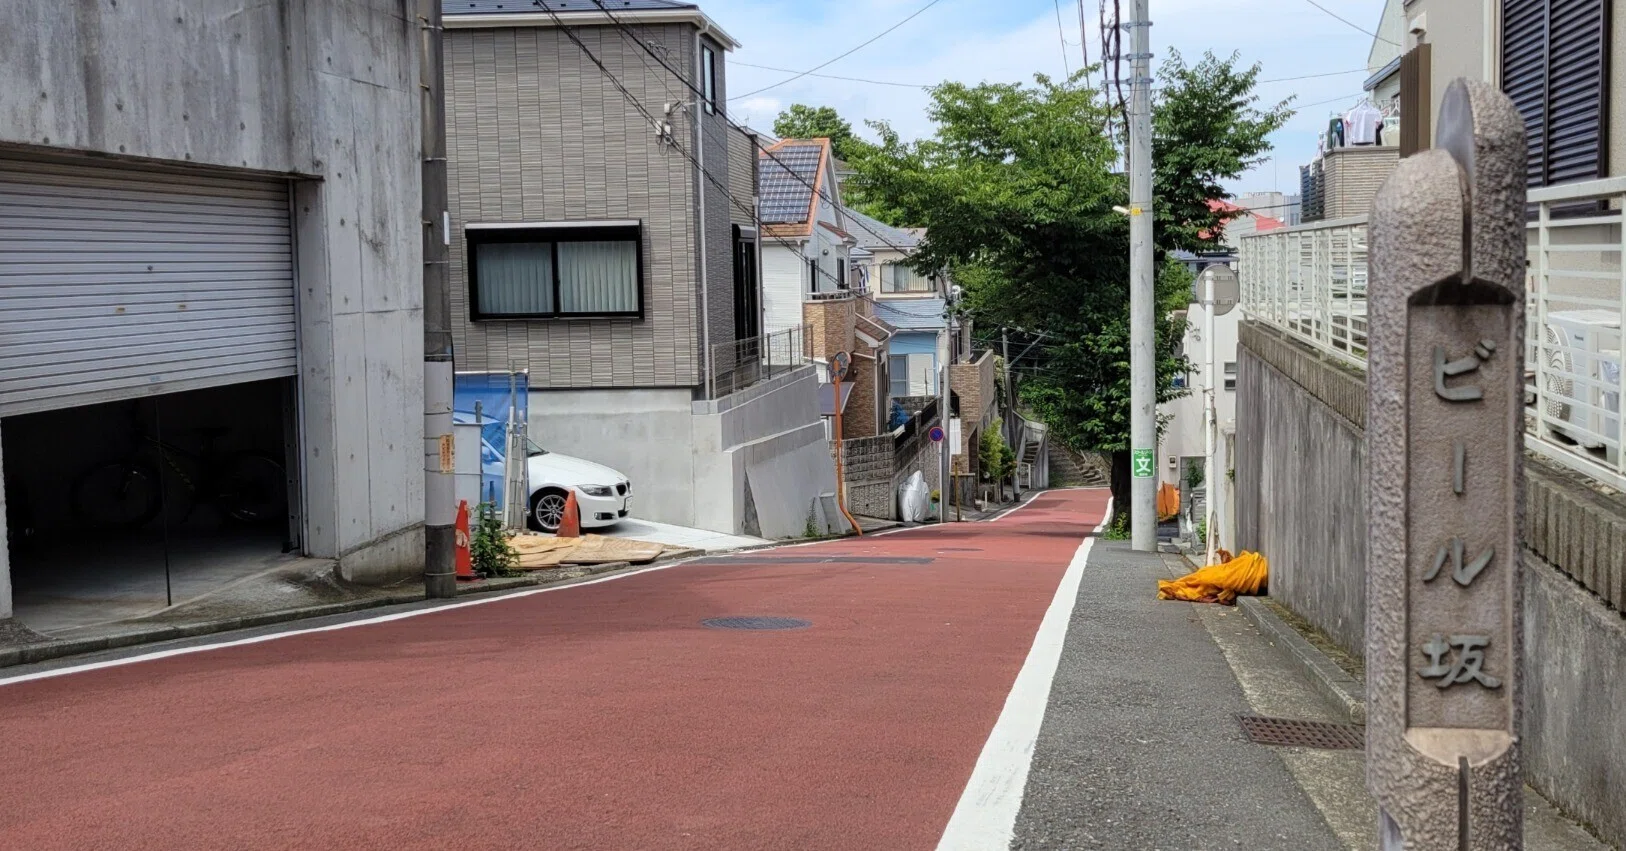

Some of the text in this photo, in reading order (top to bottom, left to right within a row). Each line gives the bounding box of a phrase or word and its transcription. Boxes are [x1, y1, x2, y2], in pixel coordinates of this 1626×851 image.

[1136, 457, 1151, 473] 文
[1417, 339, 1503, 688] ビール坂
